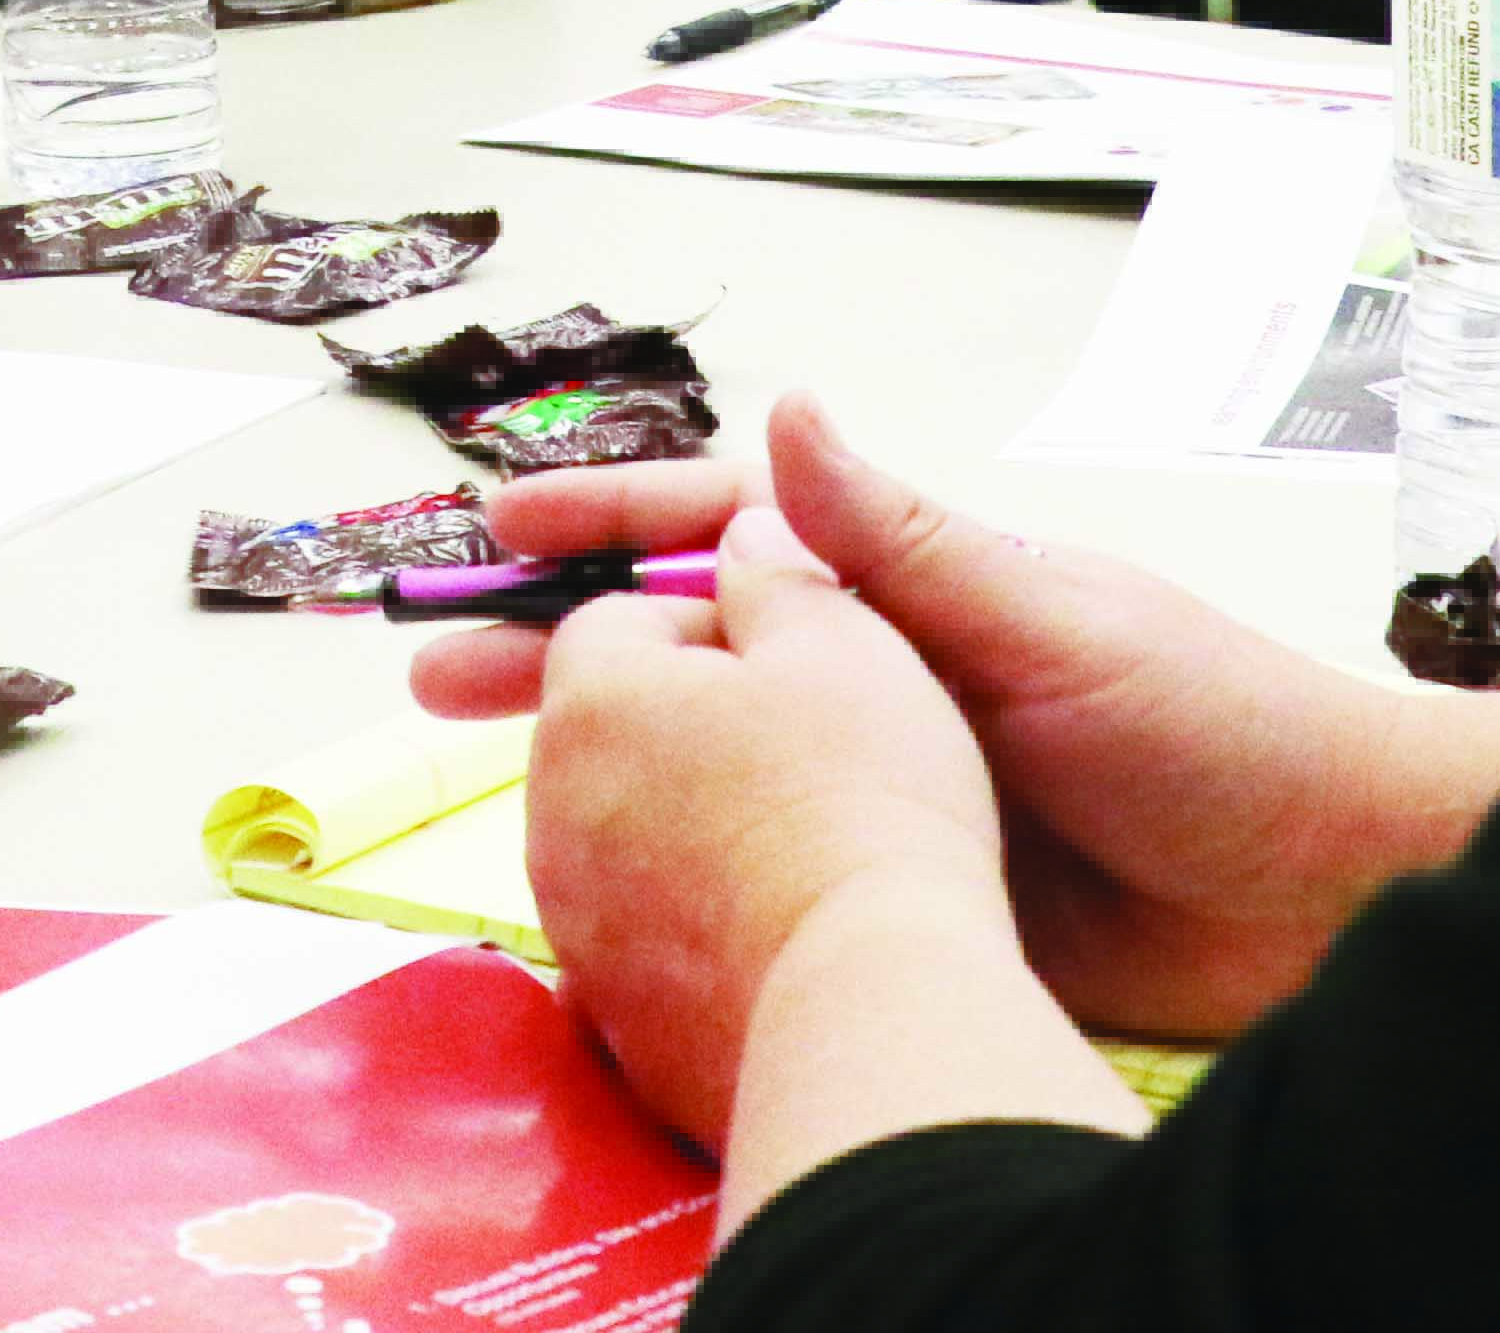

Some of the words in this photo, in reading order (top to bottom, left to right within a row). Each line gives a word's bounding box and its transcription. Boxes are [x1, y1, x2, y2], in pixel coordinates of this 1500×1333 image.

[1467, 20, 1480, 88] REFUND
[1467, 93, 1480, 138] CASH
[1467, 143, 1480, 165] CA
